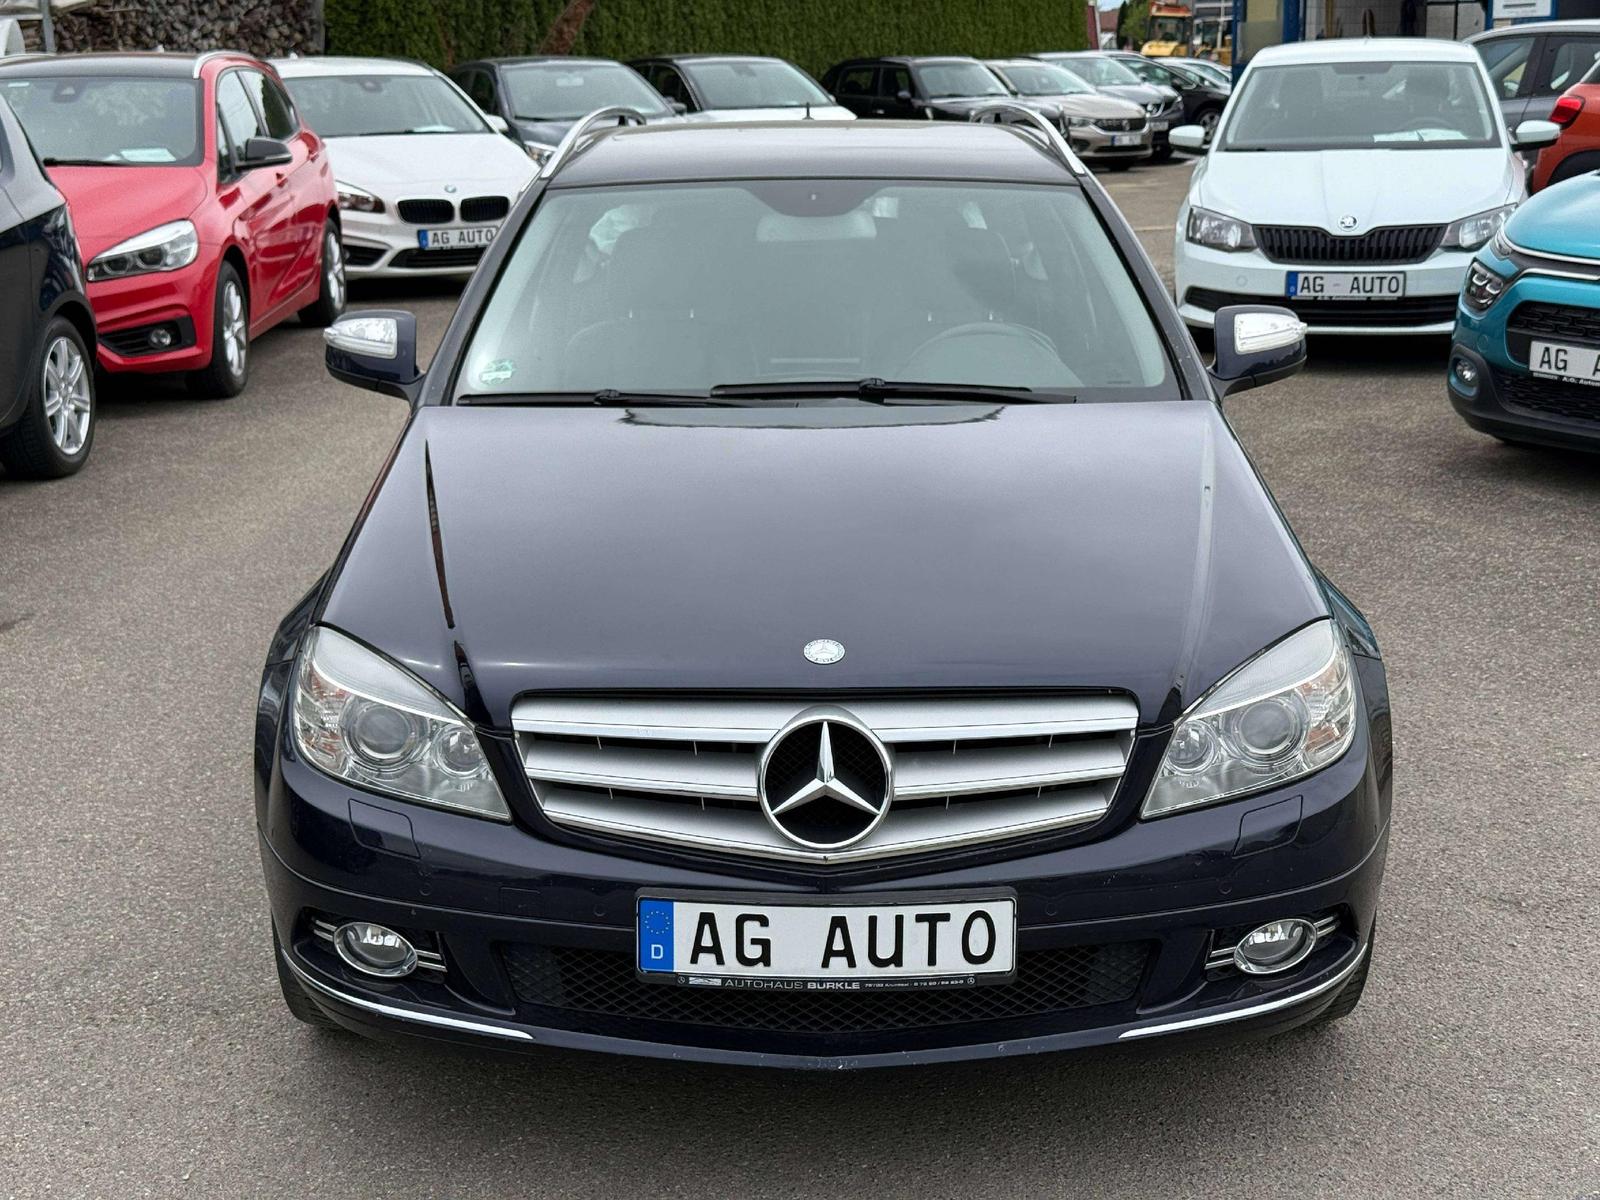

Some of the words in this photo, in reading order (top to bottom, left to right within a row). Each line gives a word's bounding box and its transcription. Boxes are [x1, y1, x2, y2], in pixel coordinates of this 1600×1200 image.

[432, 232, 450, 246] AG
[459, 229, 494, 244] AUTO
[1300, 276, 1325, 293] AG
[1349, 276, 1400, 294] AUTO
[1539, 346, 1568, 372] AG
[690, 911, 771, 967] AG
[821, 910, 996, 968] AUTO
[651, 944, 663, 959] D
[724, 979, 803, 990] AUTOHAUS
